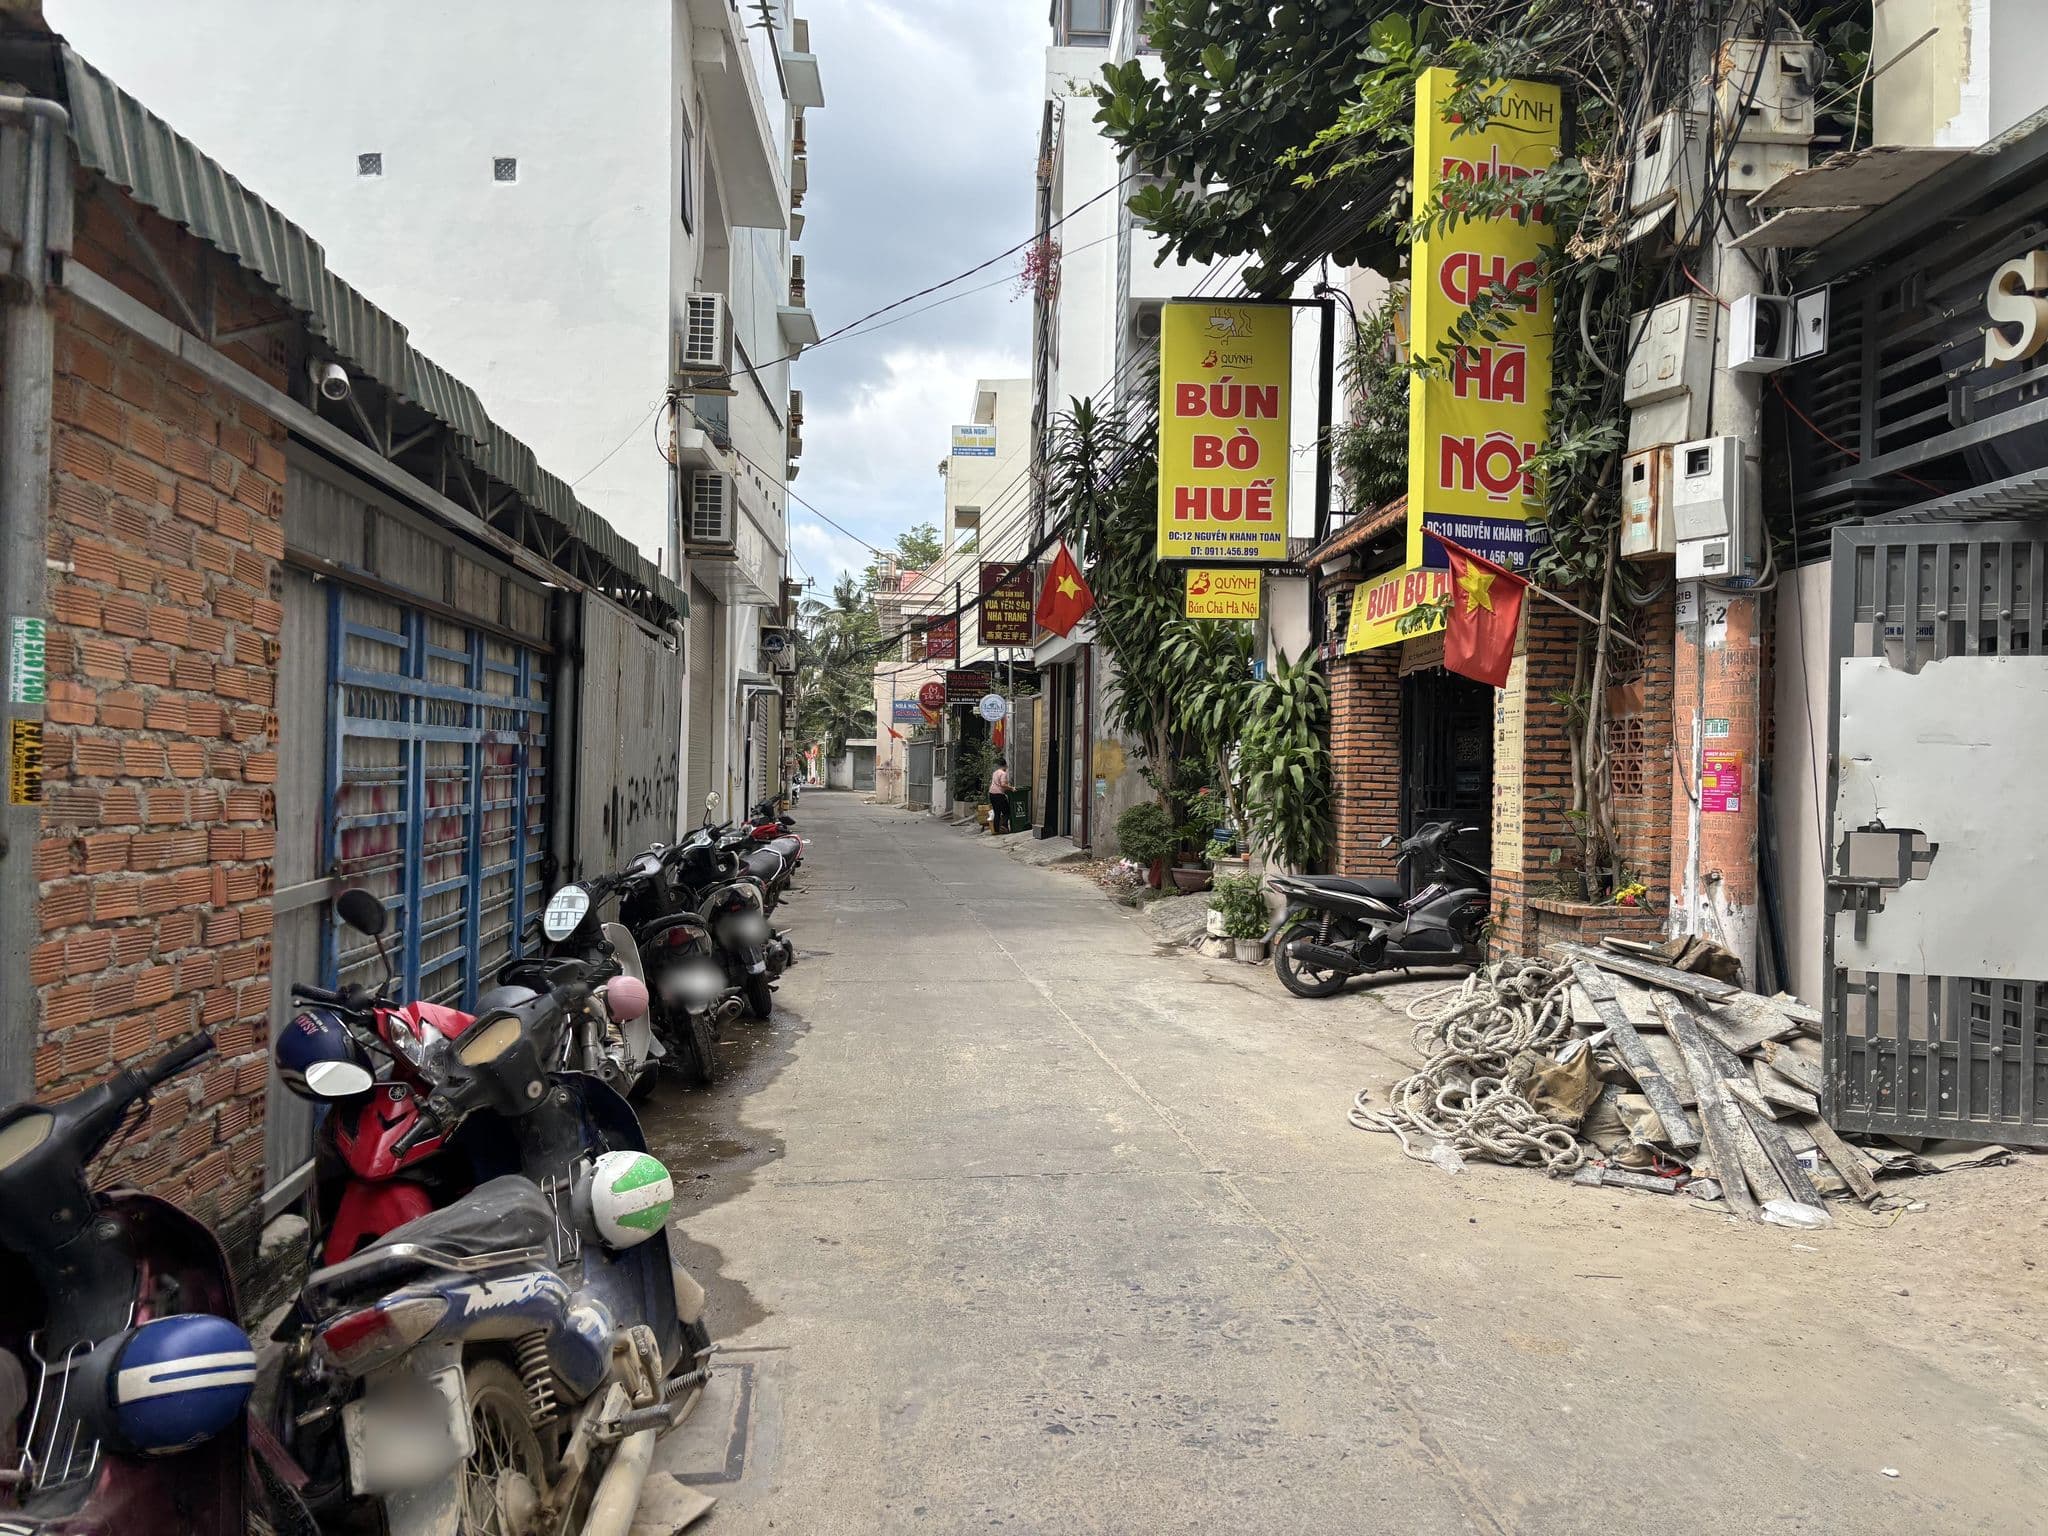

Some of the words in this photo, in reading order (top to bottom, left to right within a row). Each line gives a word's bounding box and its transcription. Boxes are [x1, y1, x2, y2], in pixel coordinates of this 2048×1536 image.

[1175, 375, 1279, 419] BÚN
[1192, 426, 1260, 470] BÒ
[1173, 478, 1276, 522] HUẾ
[1168, 531, 1192, 541] ĐC:12
[1455, 520, 1491, 541] NGUYỄN
[1493, 525, 1523, 542] KHÁNH
[1190, 546, 1203, 556] ĐT:
[1204, 547, 1259, 556] 0911.456.899
[1214, 574, 1257, 590] QUỲNH
[984, 599, 999, 610] VUA
[1366, 577, 1400, 622] BÚN
[987, 611, 1002, 622] NHA
[1004, 611, 1028, 622] TRANG
[1188, 600, 1204, 614] Bún
[1226, 600, 1239, 614] Hà
[1241, 600, 1257, 617] Nội
